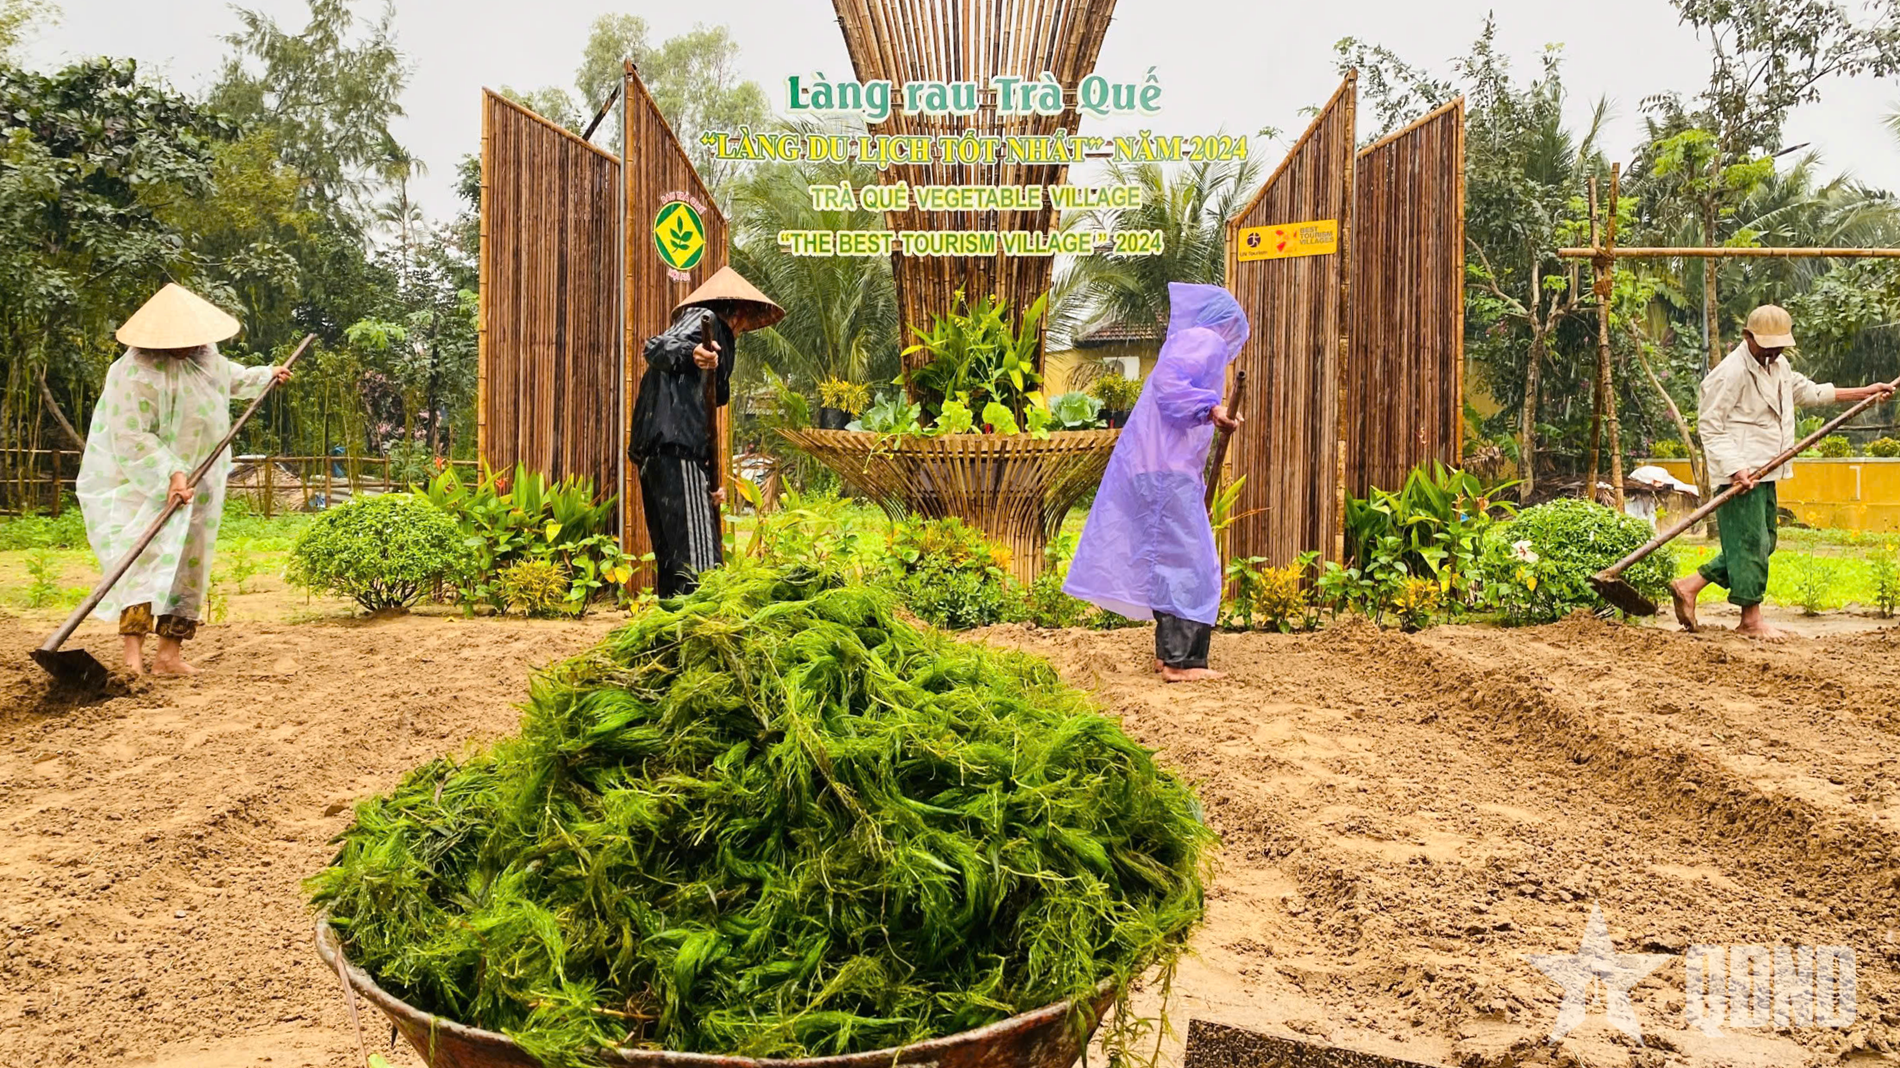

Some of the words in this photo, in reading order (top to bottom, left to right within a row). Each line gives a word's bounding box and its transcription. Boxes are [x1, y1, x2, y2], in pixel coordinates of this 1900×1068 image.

[788, 71, 891, 120] Làng
[905, 82, 978, 112] rau
[993, 73, 1063, 112] Trà
[1079, 65, 1163, 115] Quế
[806, 134, 851, 161] DU
[858, 135, 932, 168] LỊCH
[938, 130, 1001, 164] TỐT
[1112, 130, 1184, 162] NĂM
[1188, 134, 1249, 161] 2024
[810, 183, 857, 209] TRÀ
[915, 187, 1042, 209] VEGETABLE
[1050, 186, 1141, 208] VILLAGE
[1299, 226, 1319, 234] BEST
[1299, 231, 1334, 240] TOURISM
[838, 233, 895, 254] BEST
[902, 233, 996, 254] TOURISM
[1115, 233, 1163, 253] 2024
[1299, 237, 1335, 246] VILLAGES
